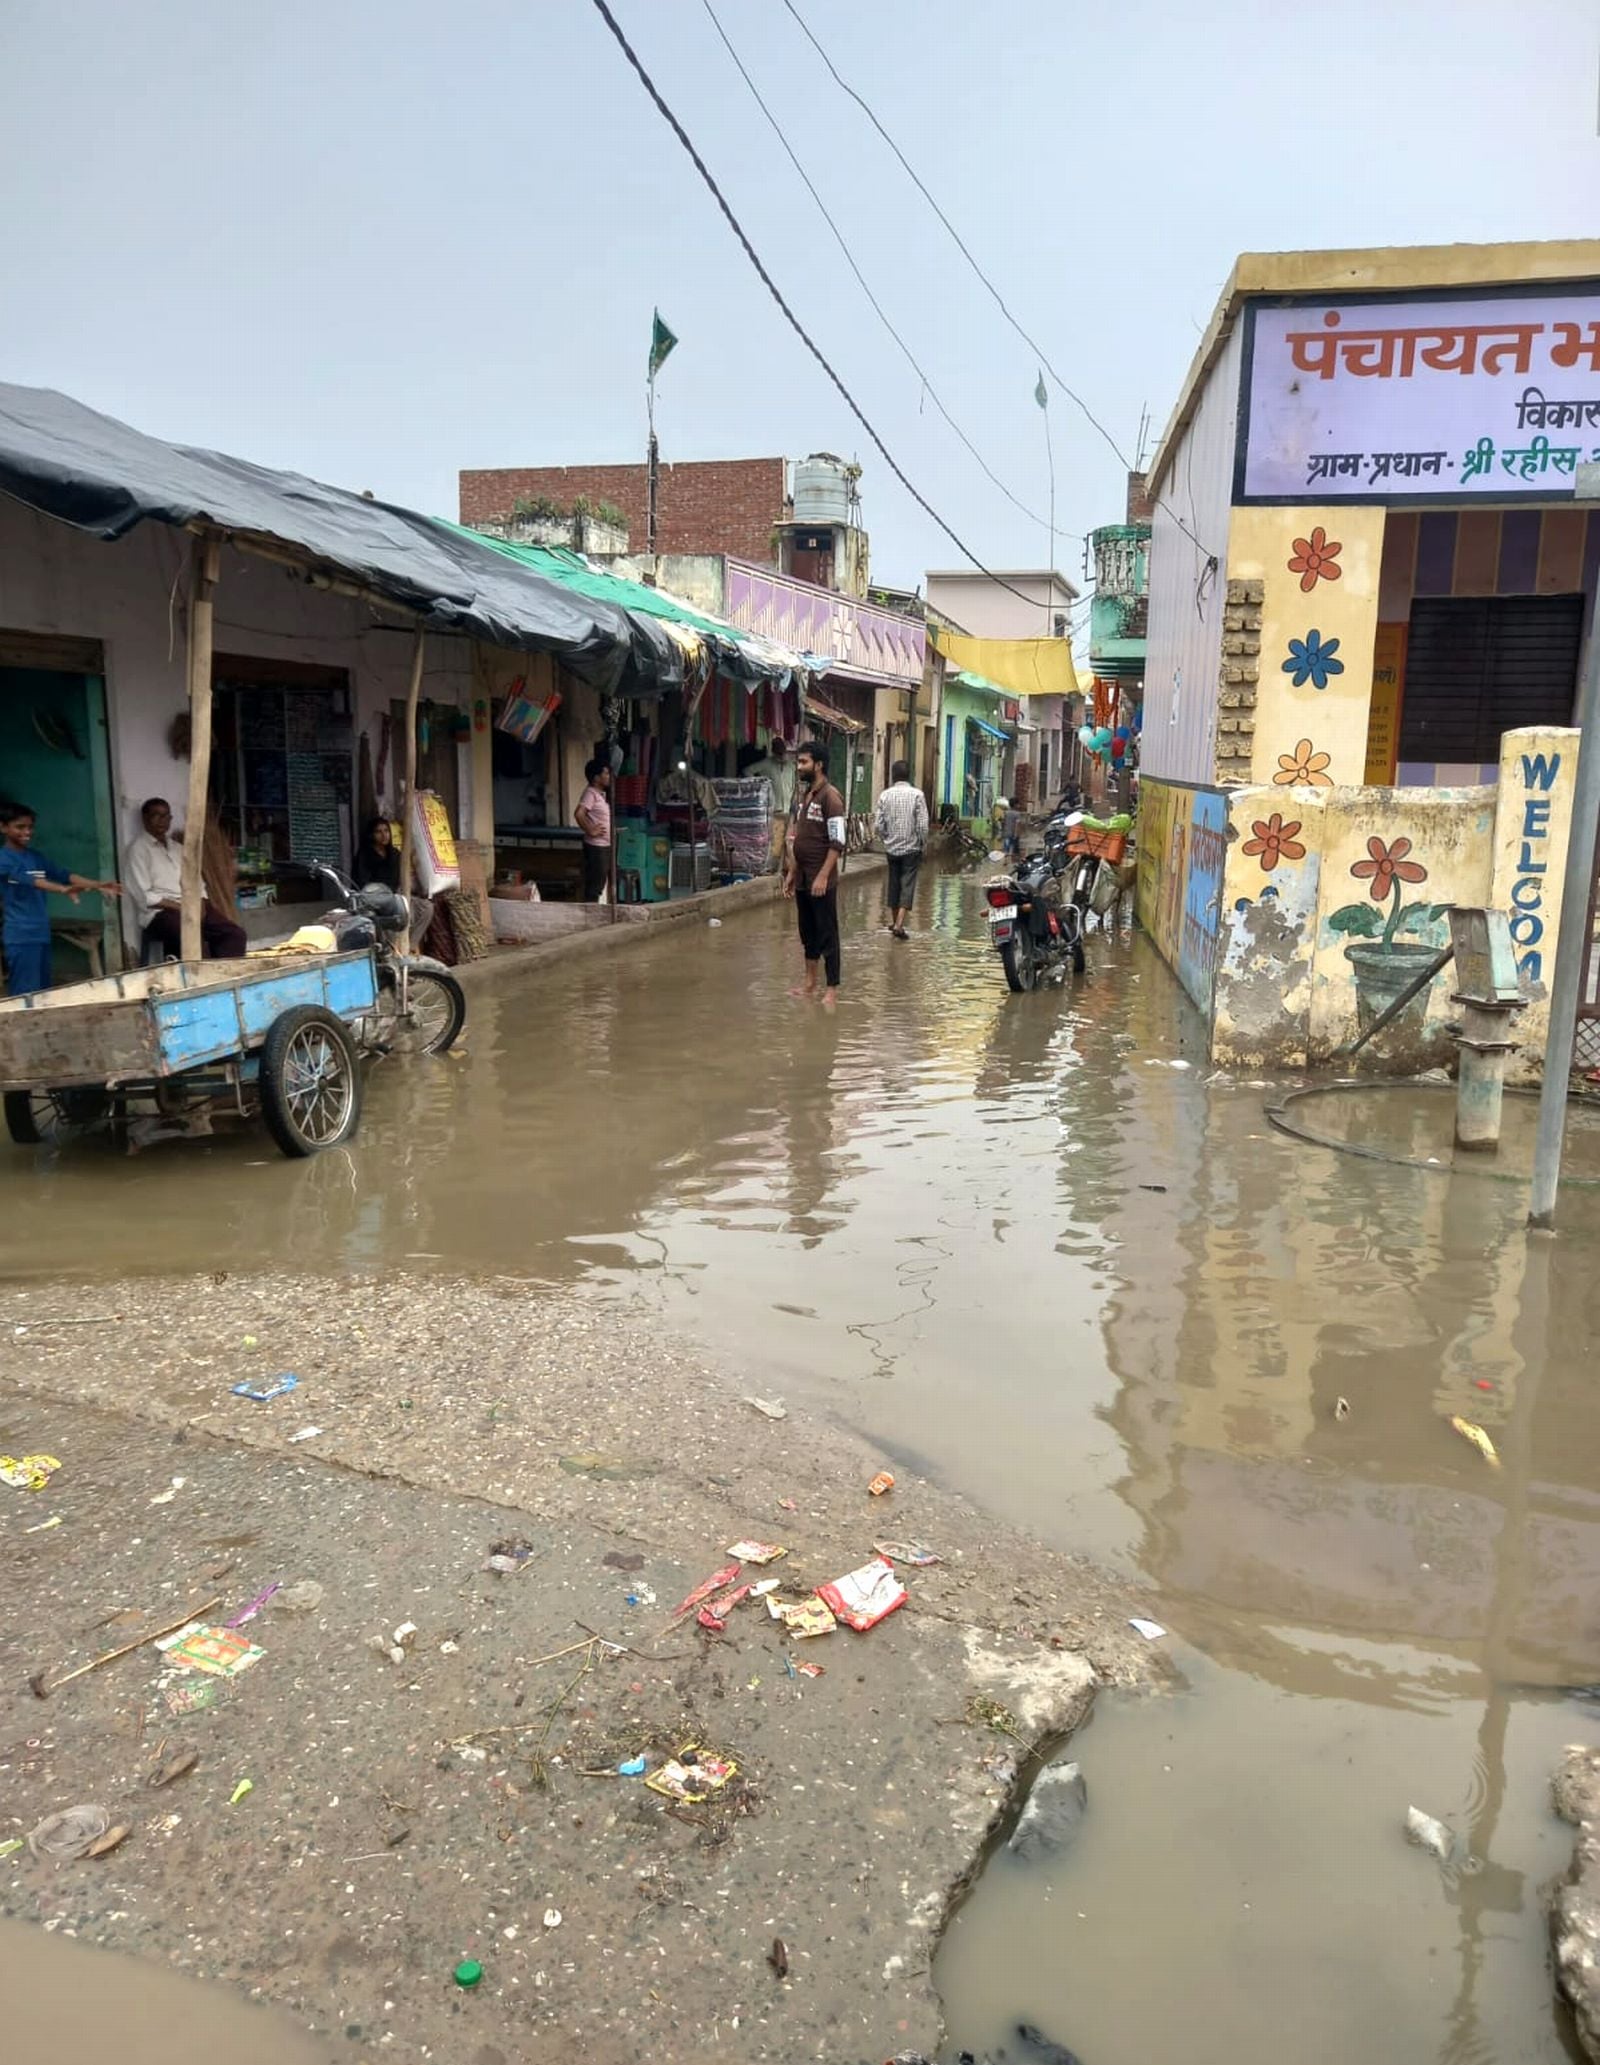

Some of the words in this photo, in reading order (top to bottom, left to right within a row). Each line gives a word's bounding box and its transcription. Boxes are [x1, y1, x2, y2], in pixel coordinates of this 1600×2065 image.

[1285, 310, 1545, 380] पंचायत
[1460, 437, 1495, 484] श्री
[1501, 435, 1582, 482] रहीस
